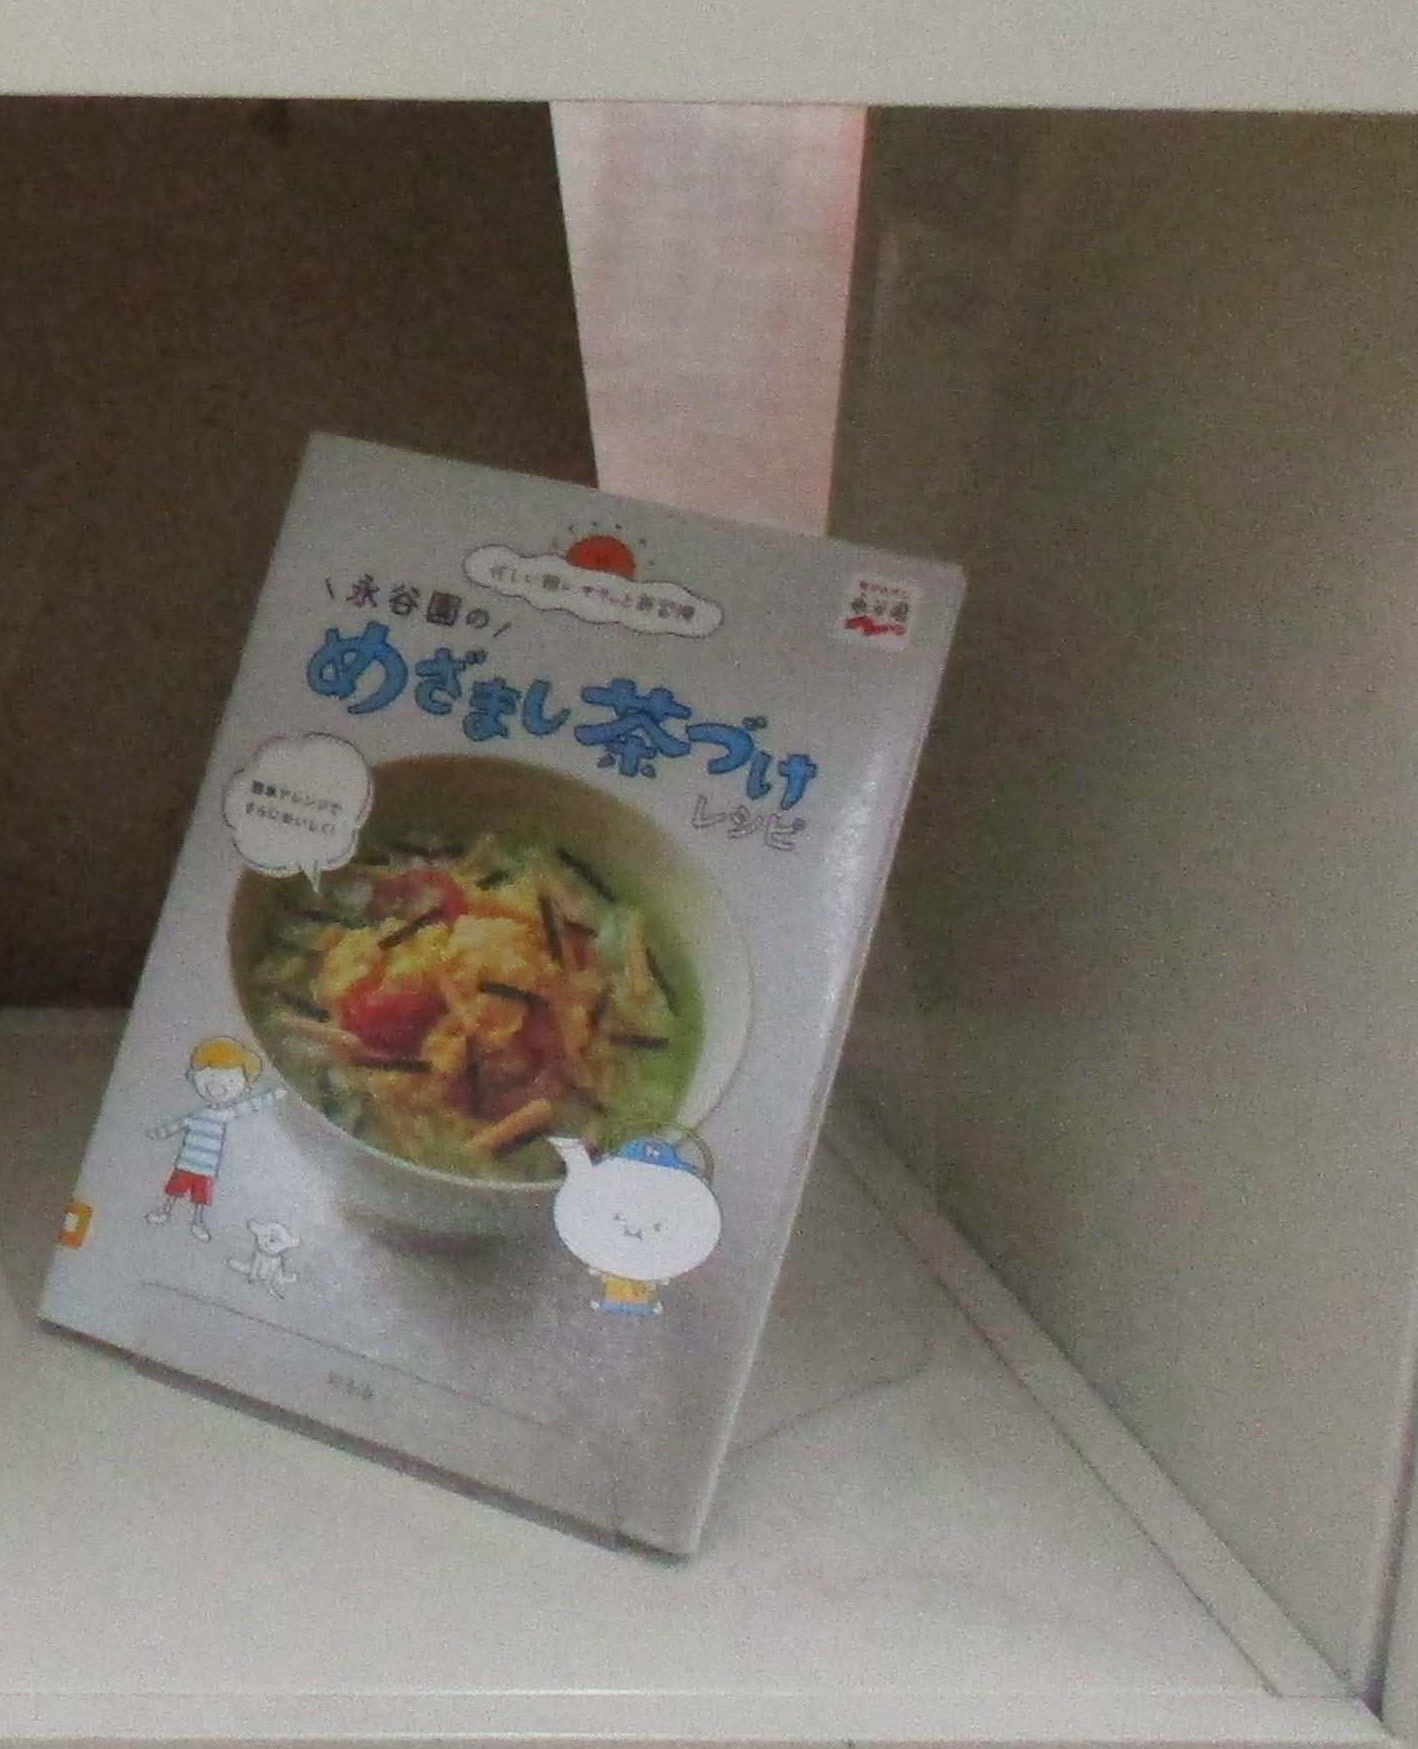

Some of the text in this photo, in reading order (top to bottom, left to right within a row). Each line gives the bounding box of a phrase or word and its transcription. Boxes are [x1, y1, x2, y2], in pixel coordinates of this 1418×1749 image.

[344, 574, 493, 629] 永谷園の
[306, 620, 819, 811] めざまし茶づけ
[692, 795, 807, 853] レシピ
